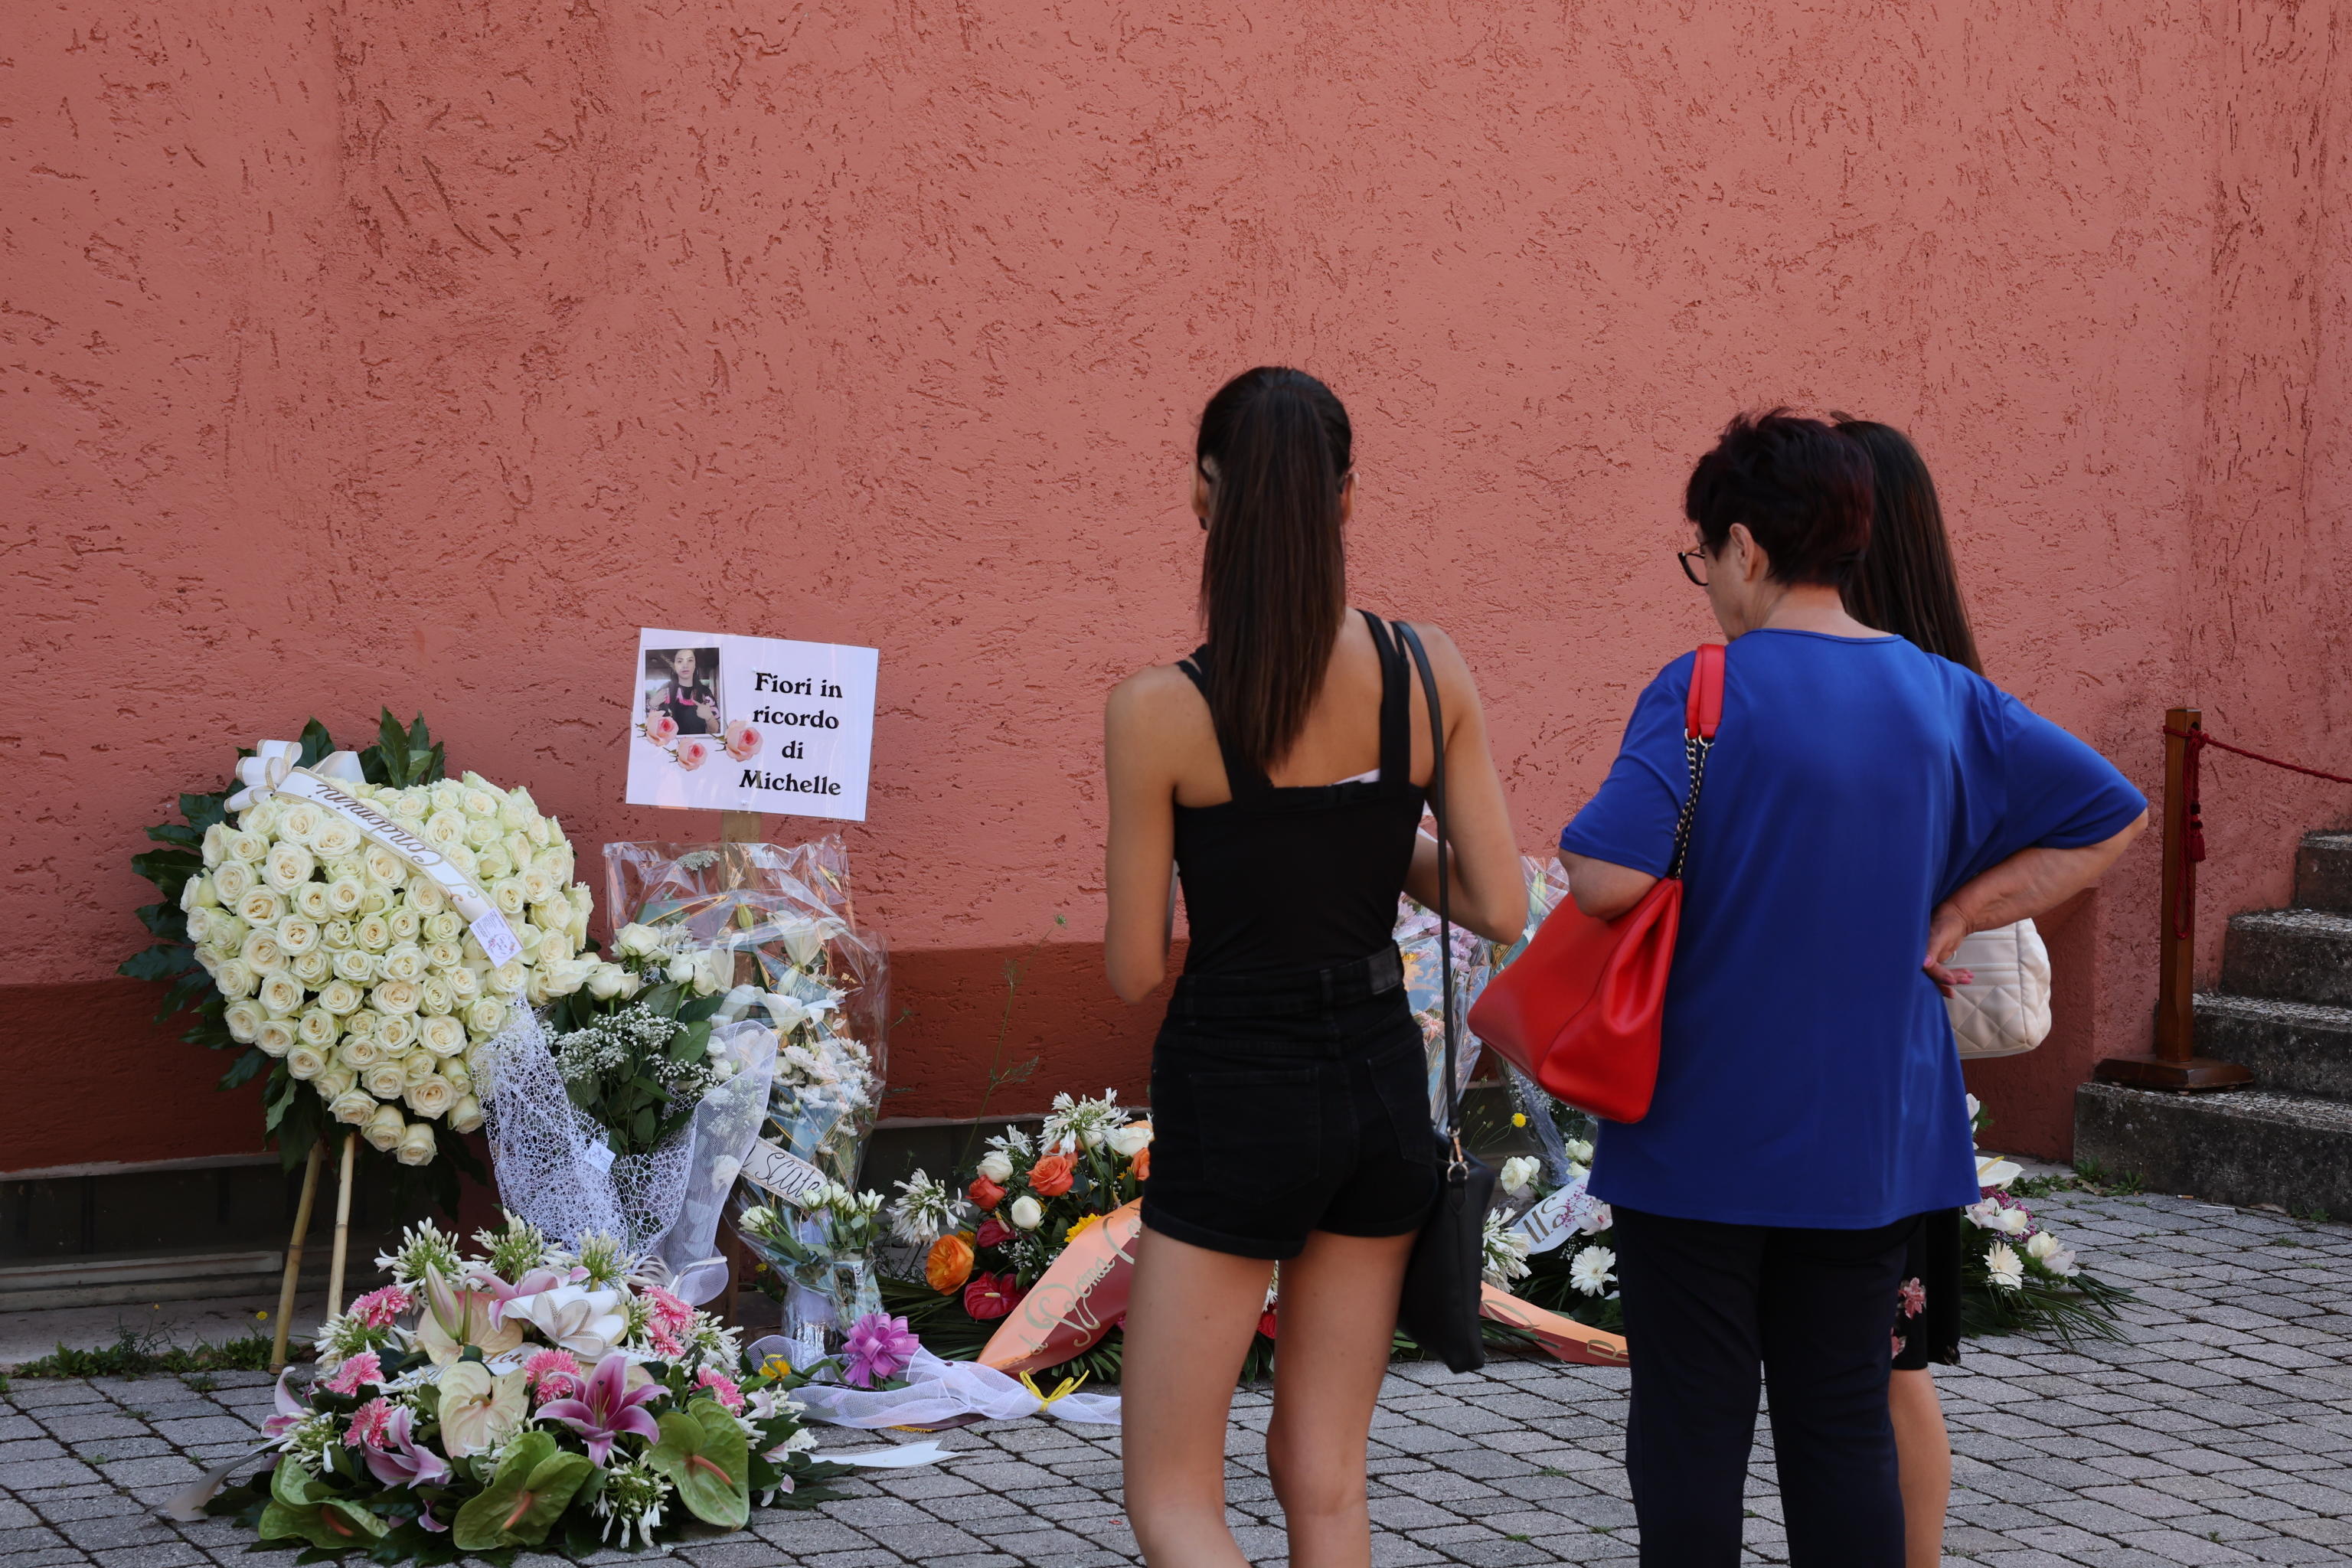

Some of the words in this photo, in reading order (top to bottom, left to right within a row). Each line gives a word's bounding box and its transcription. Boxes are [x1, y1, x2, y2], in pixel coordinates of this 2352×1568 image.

[755, 672, 812, 695] Fiori
[820, 679, 843, 698] in
[753, 706, 839, 729] ricordo
[782, 740, 803, 760] di
[739, 769, 841, 795] Michelle
